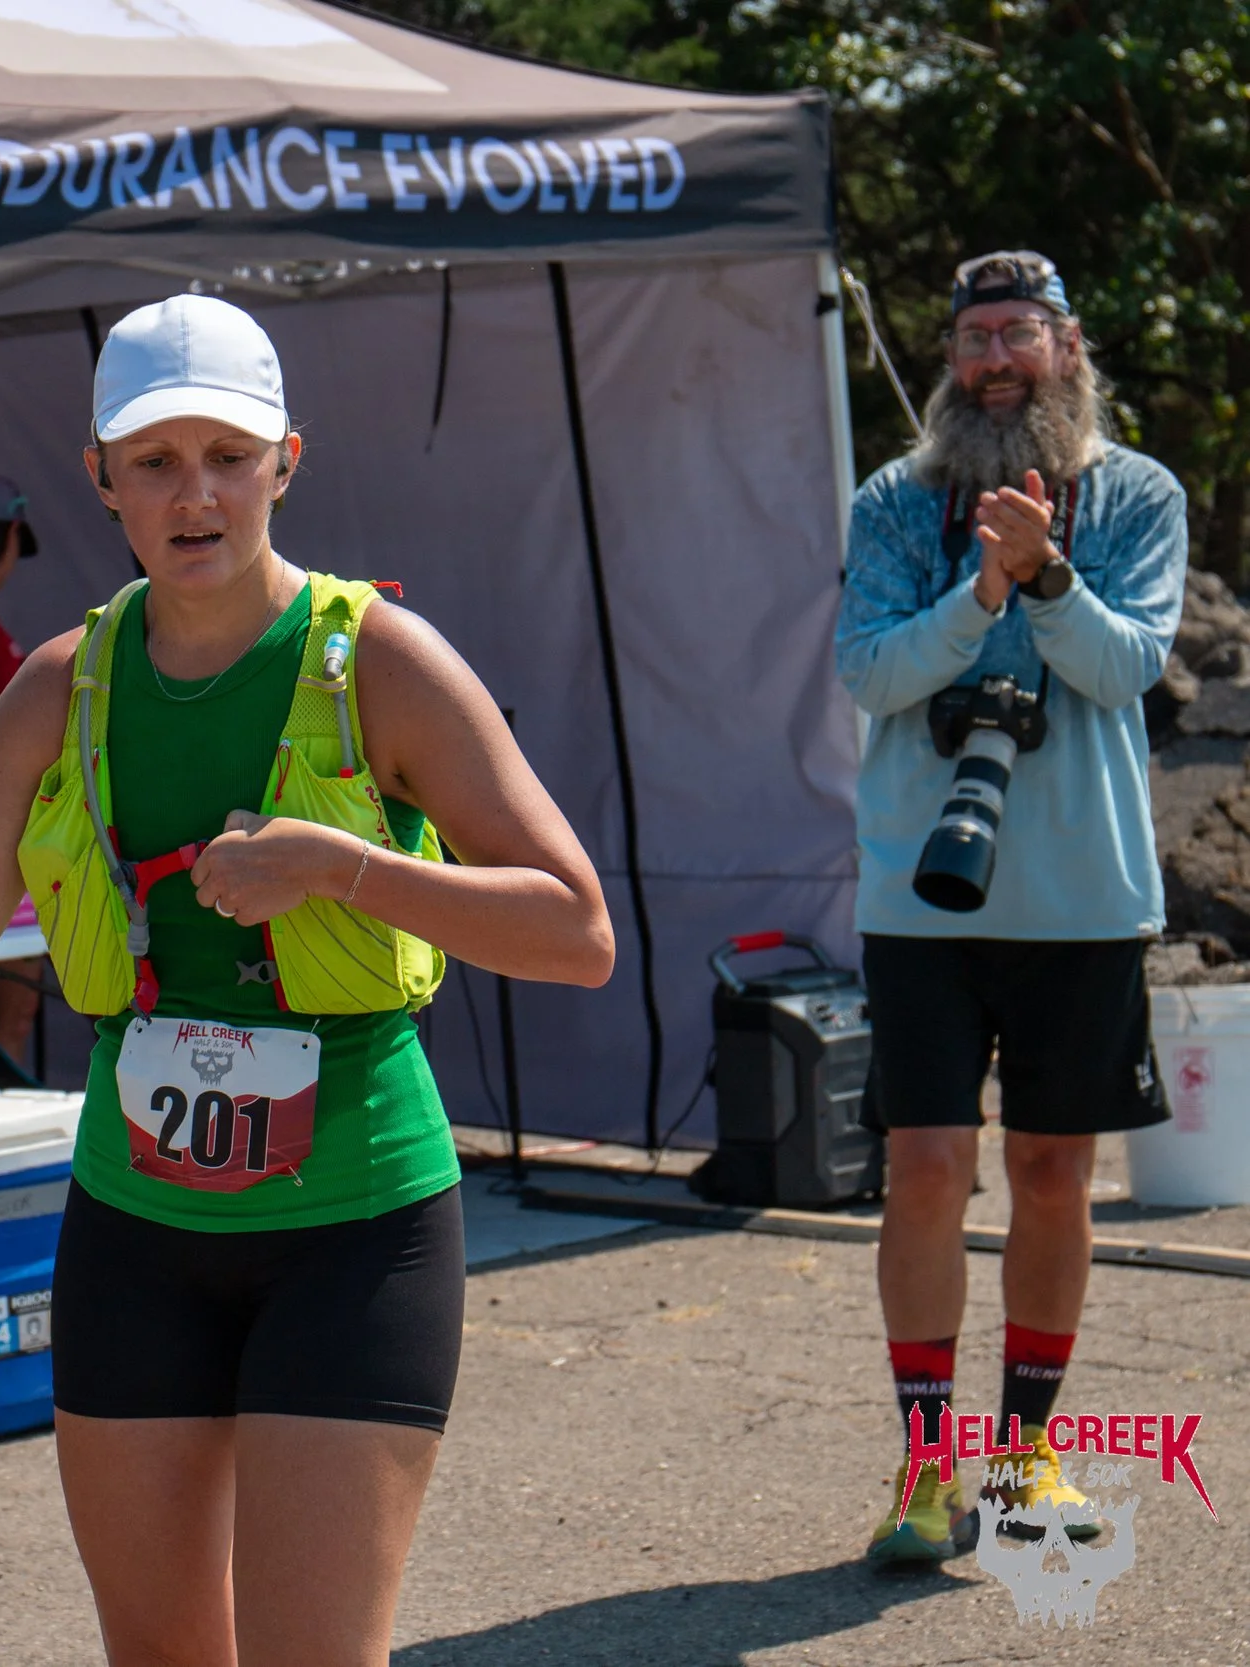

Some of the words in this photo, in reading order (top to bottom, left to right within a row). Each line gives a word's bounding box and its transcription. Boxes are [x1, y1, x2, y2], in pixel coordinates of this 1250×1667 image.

[381, 132, 686, 213] EVOLVED
[364, 785, 391, 850] NATH
[172, 1021, 211, 1054] HELL
[212, 1027, 256, 1060] CREEK
[150, 1085, 272, 1173] 201
